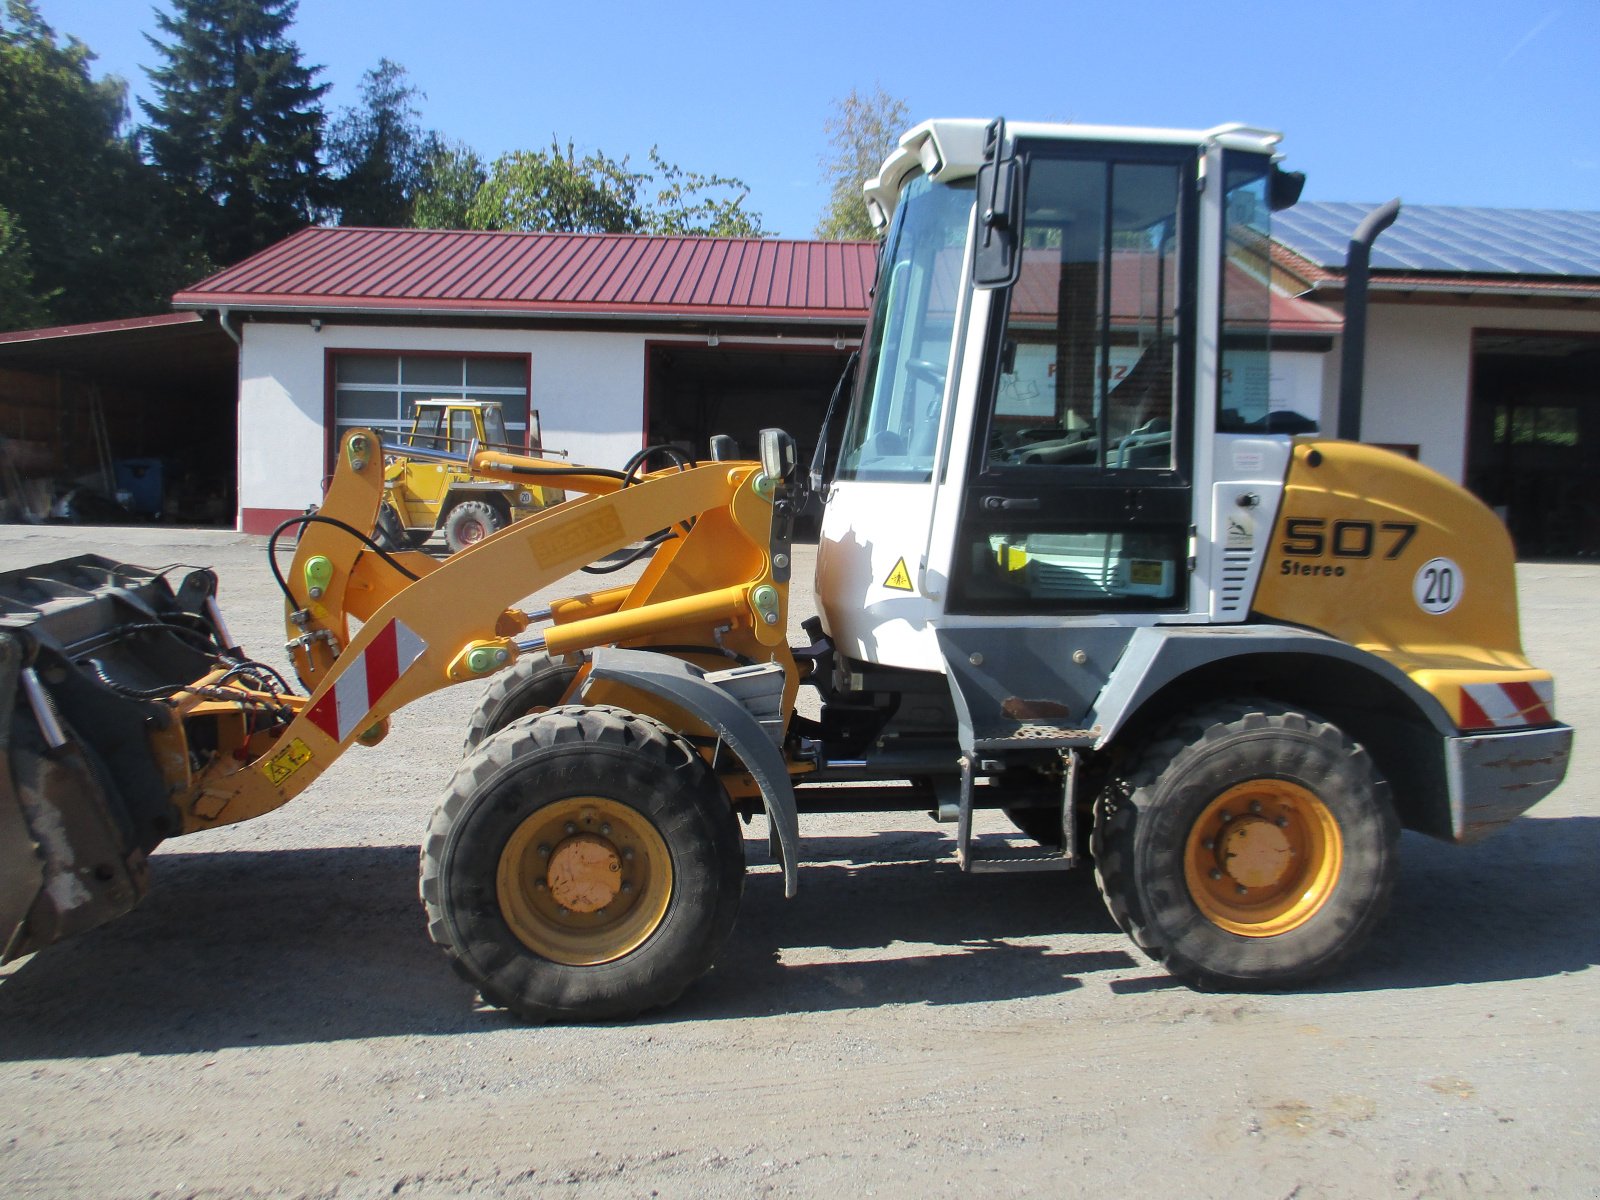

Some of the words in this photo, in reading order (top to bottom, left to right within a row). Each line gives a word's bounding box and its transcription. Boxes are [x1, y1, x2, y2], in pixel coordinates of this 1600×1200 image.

[521, 493, 530, 502] 20
[1280, 516, 1420, 560] 507
[1280, 560, 1345, 577] Stereo
[1423, 567, 1453, 604] 20
